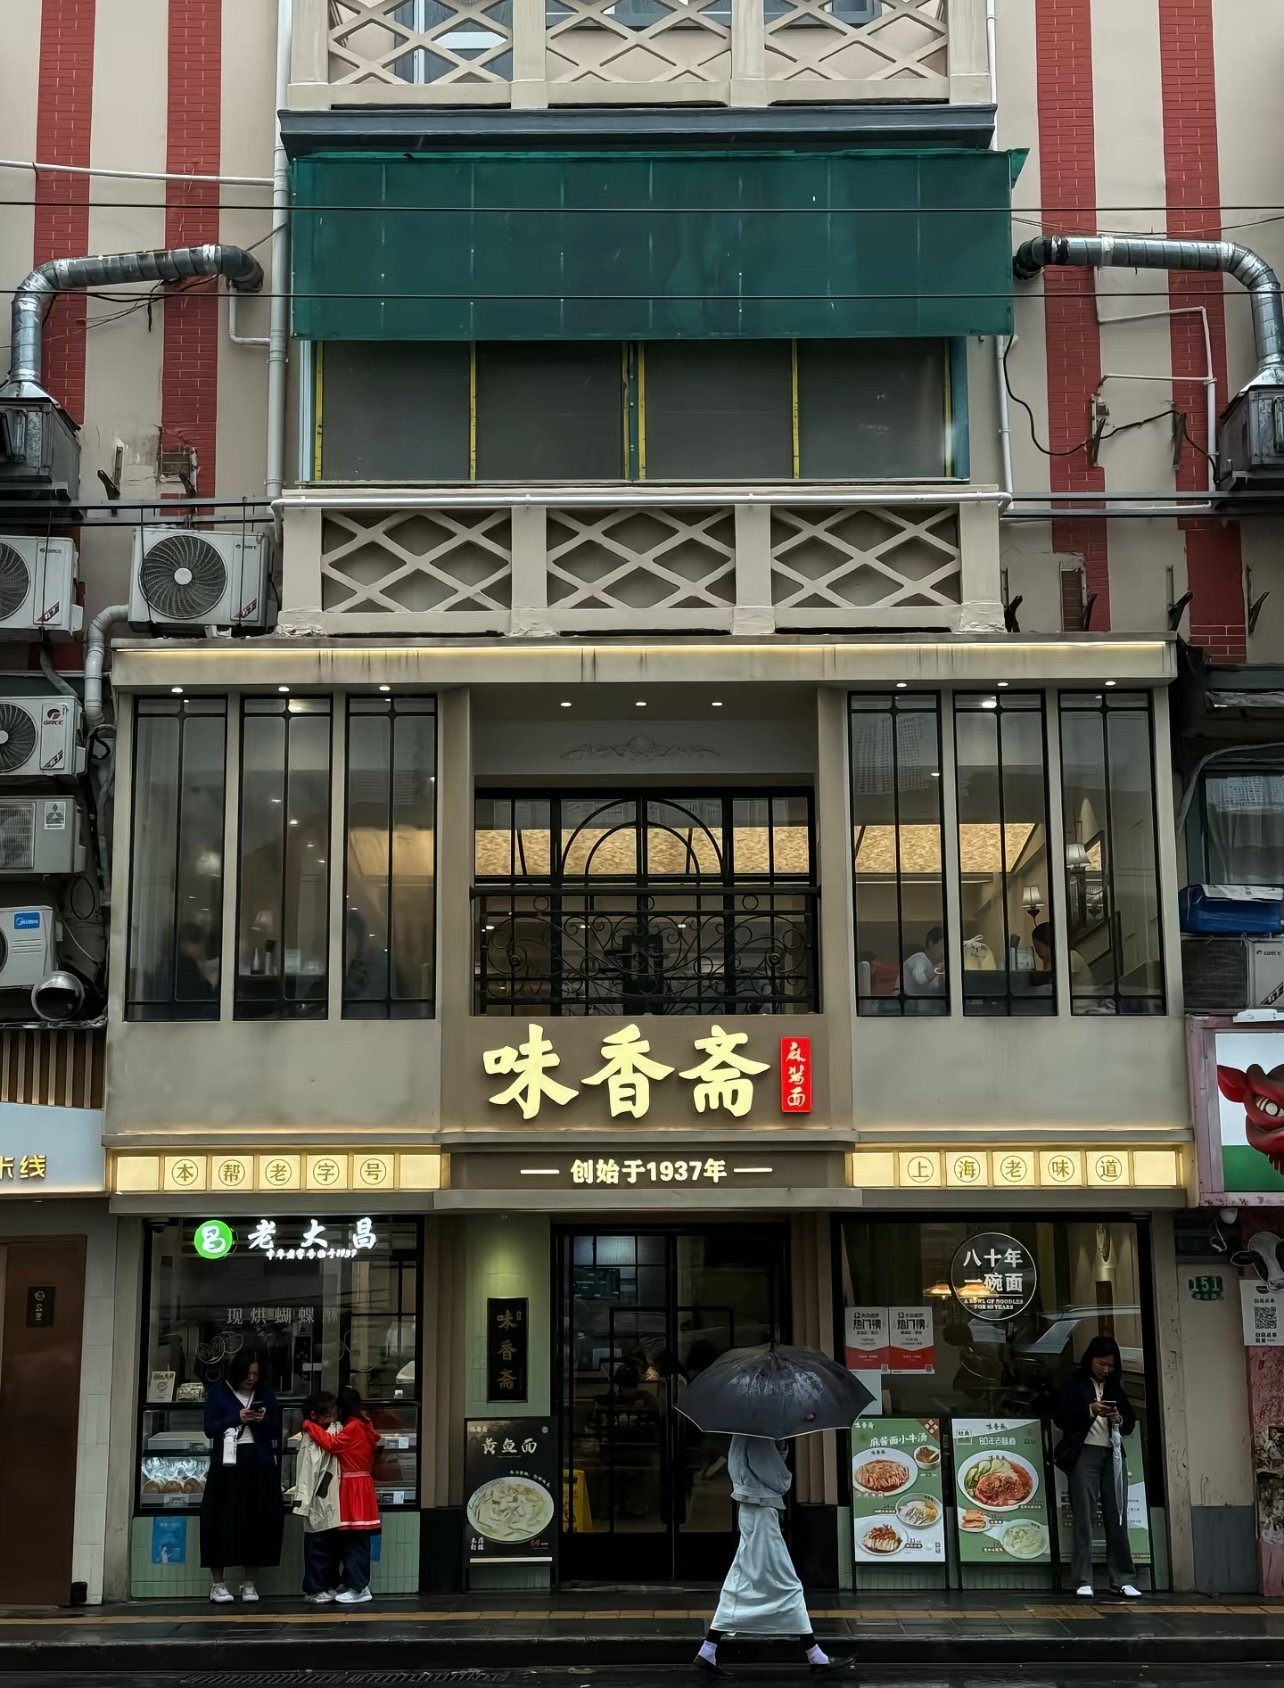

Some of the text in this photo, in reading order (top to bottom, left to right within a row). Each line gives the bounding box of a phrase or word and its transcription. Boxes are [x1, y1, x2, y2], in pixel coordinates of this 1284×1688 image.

[482, 1023, 771, 1120] 味香斋
[173, 1159, 386, 1186] 本帮老字号
[570, 1158, 728, 1184] 创始于1937年
[909, 1157, 1121, 1182] 上海老味道
[247, 1216, 378, 1250] 老大昌
[962, 1248, 1023, 1268] 八十年
[963, 1272, 1023, 1292] 一碗面
[1191, 1277, 1221, 1292] 151
[496, 1309, 518, 1390] 味香斋
[481, 1437, 538, 1455] 黄鱼面
[869, 1432, 929, 1448] 麻酱面小牛汤
